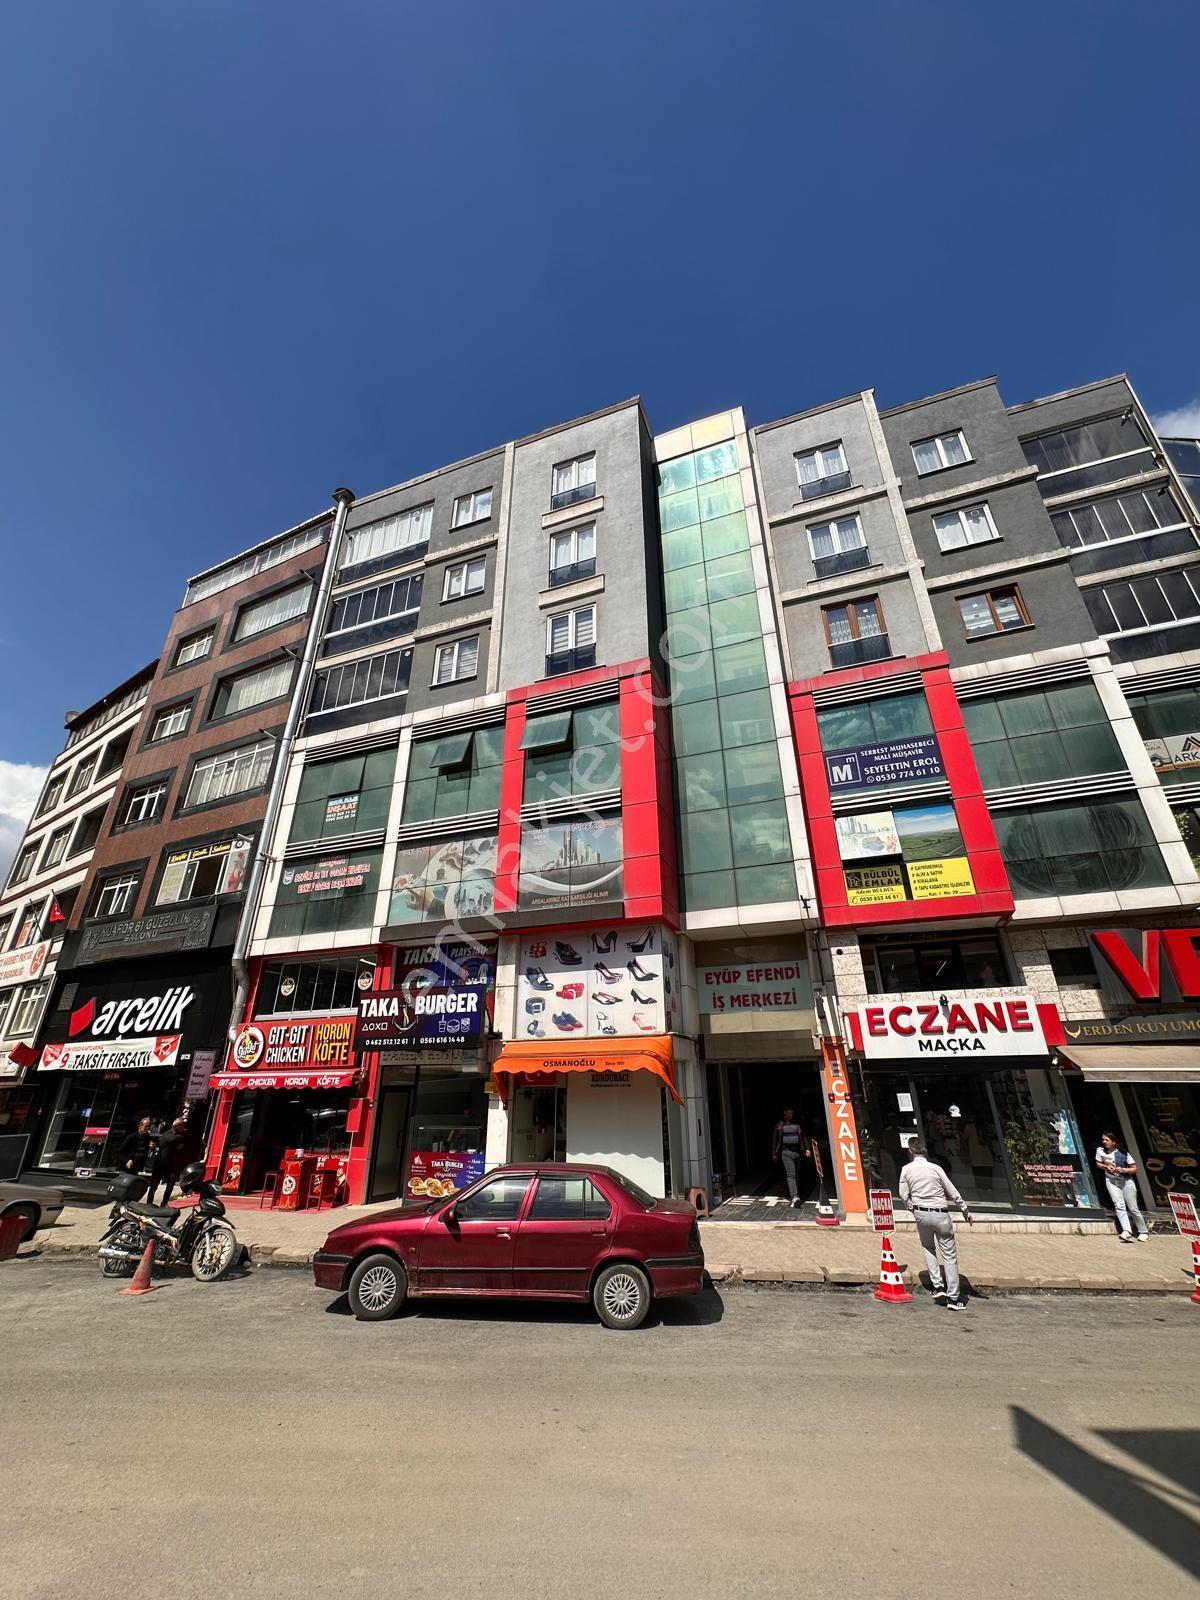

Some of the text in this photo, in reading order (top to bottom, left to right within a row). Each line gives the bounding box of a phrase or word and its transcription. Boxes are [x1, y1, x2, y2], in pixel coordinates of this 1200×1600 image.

[861, 747, 888, 757] SERBEST
[913, 757, 940, 768] EROL
[875, 767, 941, 782] 0530 774 61 10
[863, 868, 900, 879] BÜLBÜL
[865, 877, 901, 887] EMLAK
[704, 962, 801, 985] EYÜP EFENDİ
[360, 992, 478, 1018] TAKA BURGER
[712, 988, 798, 1012] İŞ MERKEZİ
[865, 1000, 1035, 1037] ECZANE
[315, 1023, 352, 1041] HORON
[313, 1040, 350, 1062] KÖFTE
[917, 1038, 986, 1054] MAÇKA
[59, 1053, 70, 1069] 9
[72, 1050, 109, 1069] TAKSİT
[265, 1046, 306, 1064] CHICKEN
[543, 1057, 596, 1067] OSMANOĞLU
[247, 1078, 277, 1086] CHICKEN
[283, 1078, 309, 1086] HORON
[316, 1076, 341, 1086] KÖFTE
[829, 1060, 858, 1181] ECZANE
[431, 1160, 444, 1168] TAKA
[444, 1160, 464, 1169] BURGER
